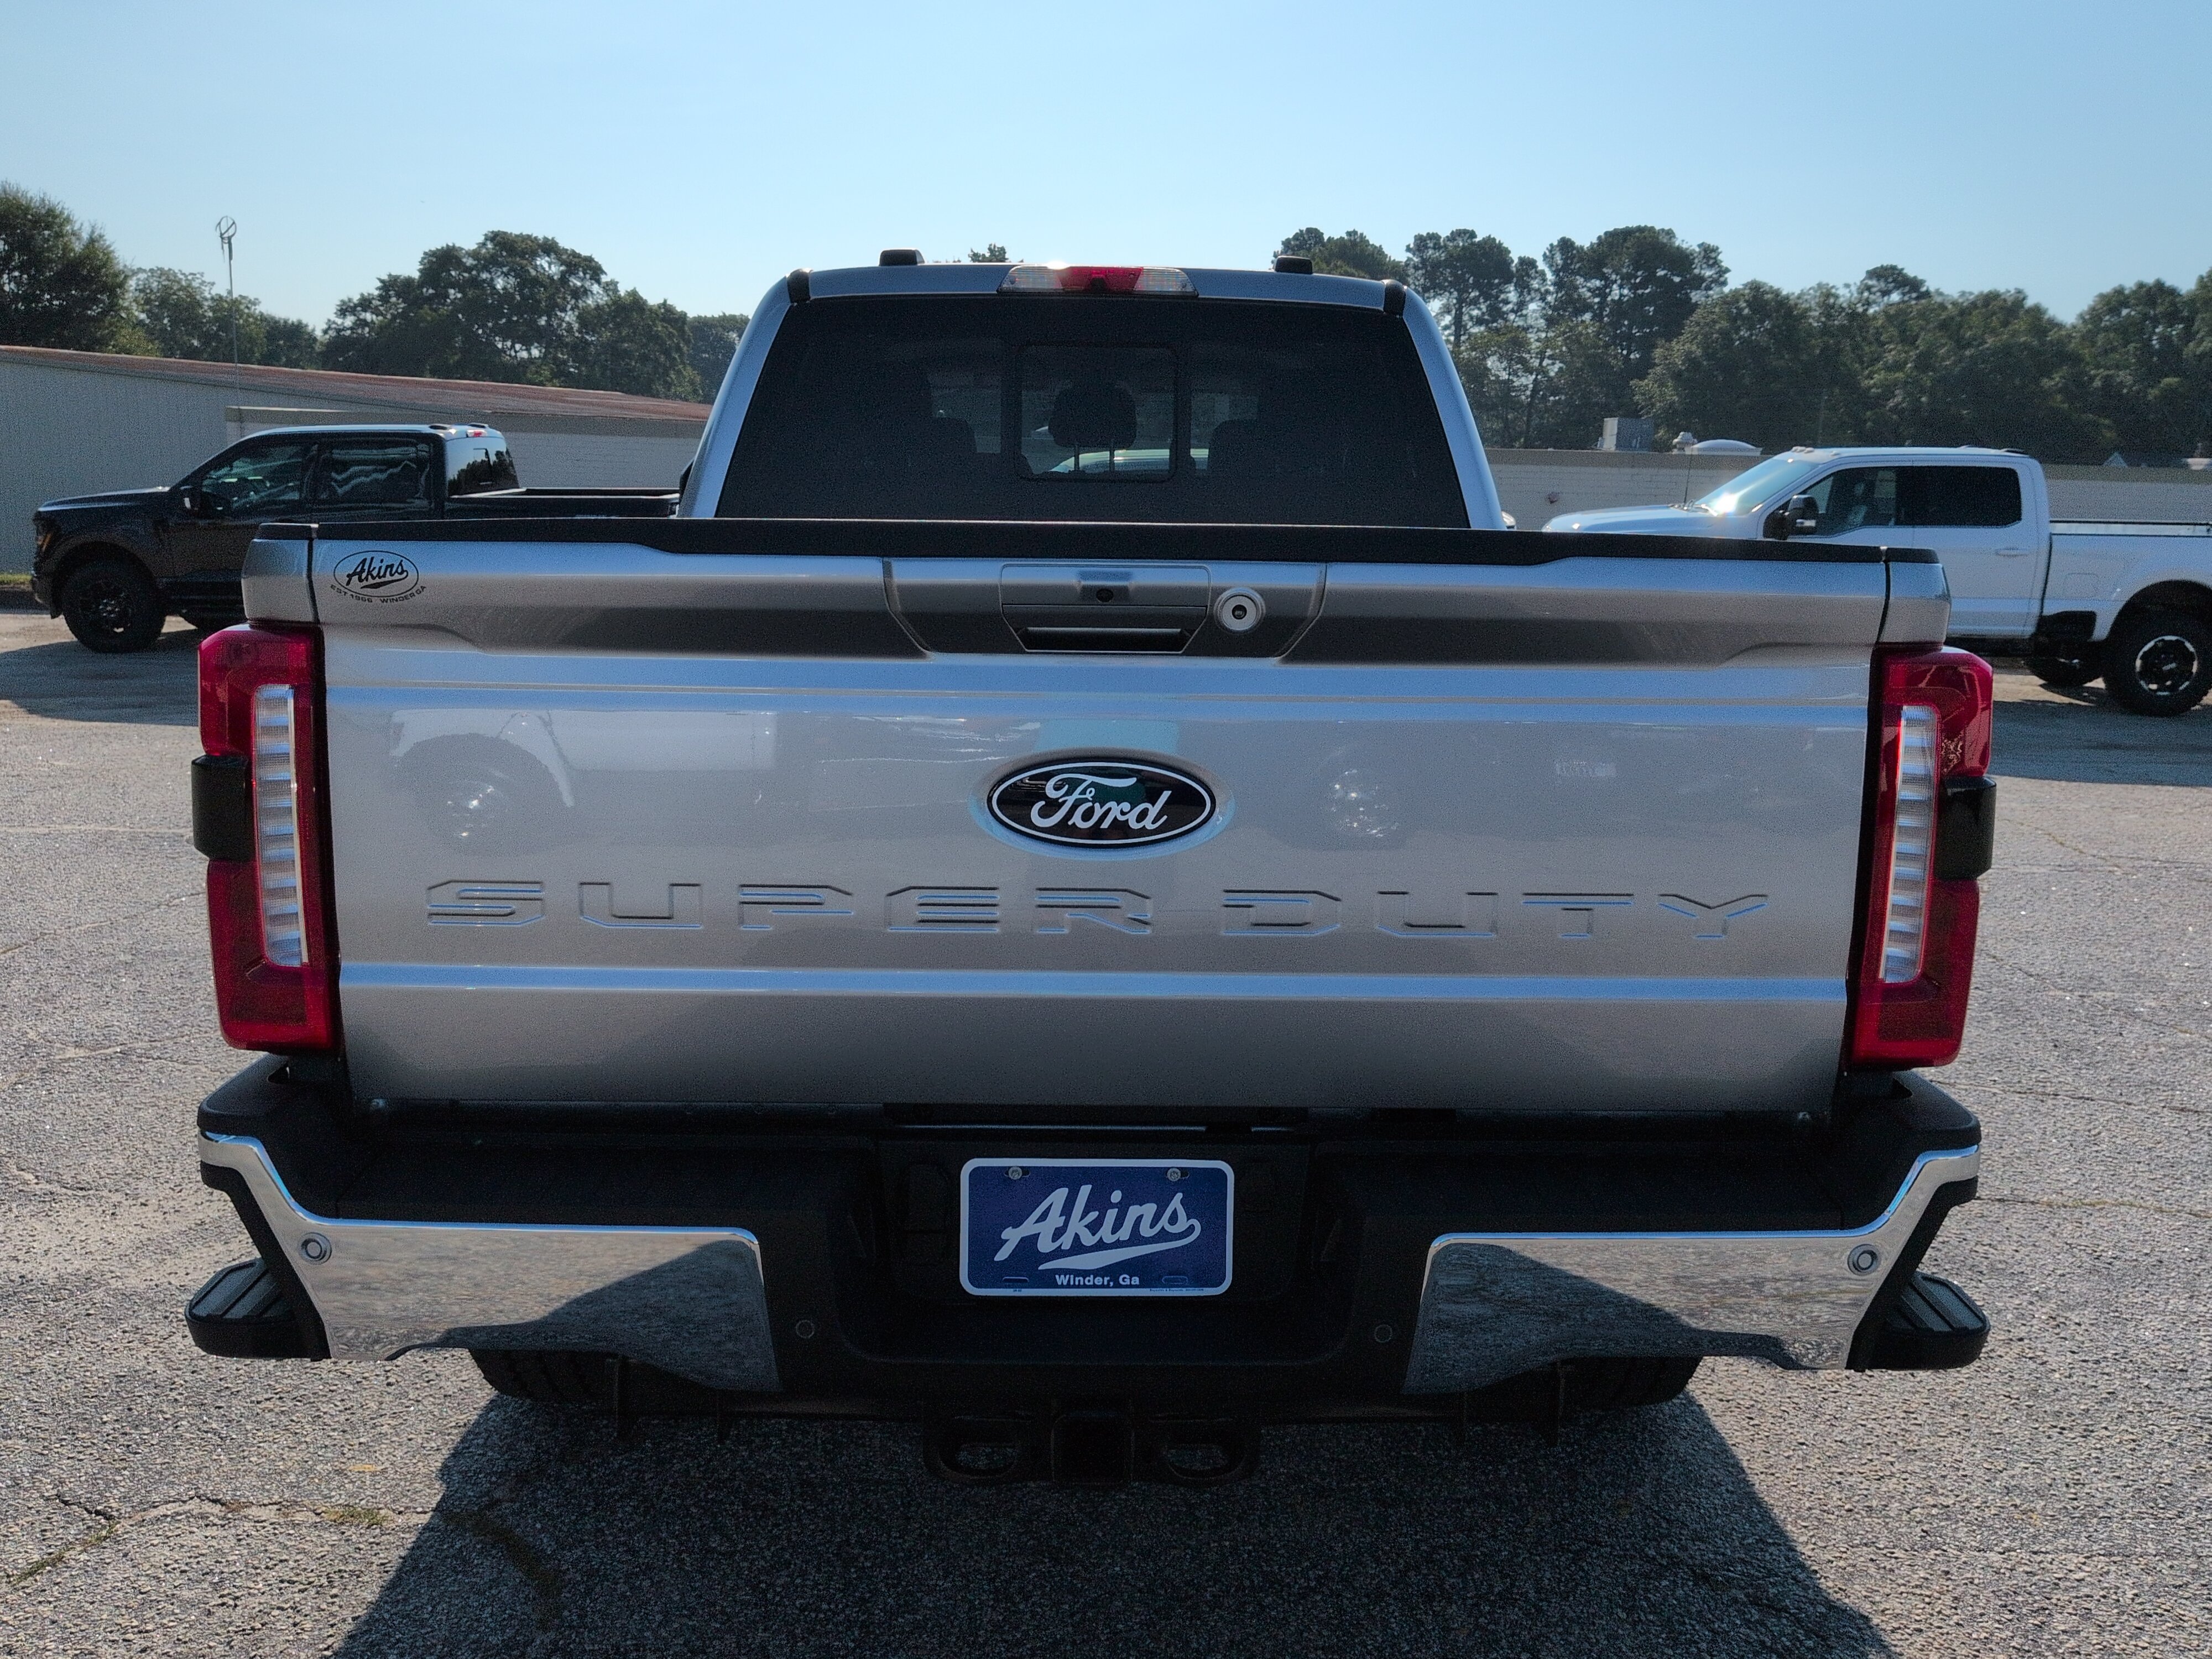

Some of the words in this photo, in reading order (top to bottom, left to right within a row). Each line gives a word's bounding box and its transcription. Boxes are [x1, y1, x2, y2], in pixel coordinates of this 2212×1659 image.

[346, 556, 408, 586] Akins
[379, 593, 416, 603] WINDER
[415, 585, 427, 595] GA
[1030, 773, 1172, 830] Ford
[427, 880, 1152, 935] SUPER
[1223, 889, 1768, 939] DUTY
[993, 1184, 1201, 1261] Akins
[1055, 1274, 1114, 1287] Winder,
[1119, 1274, 1140, 1286] Ga
